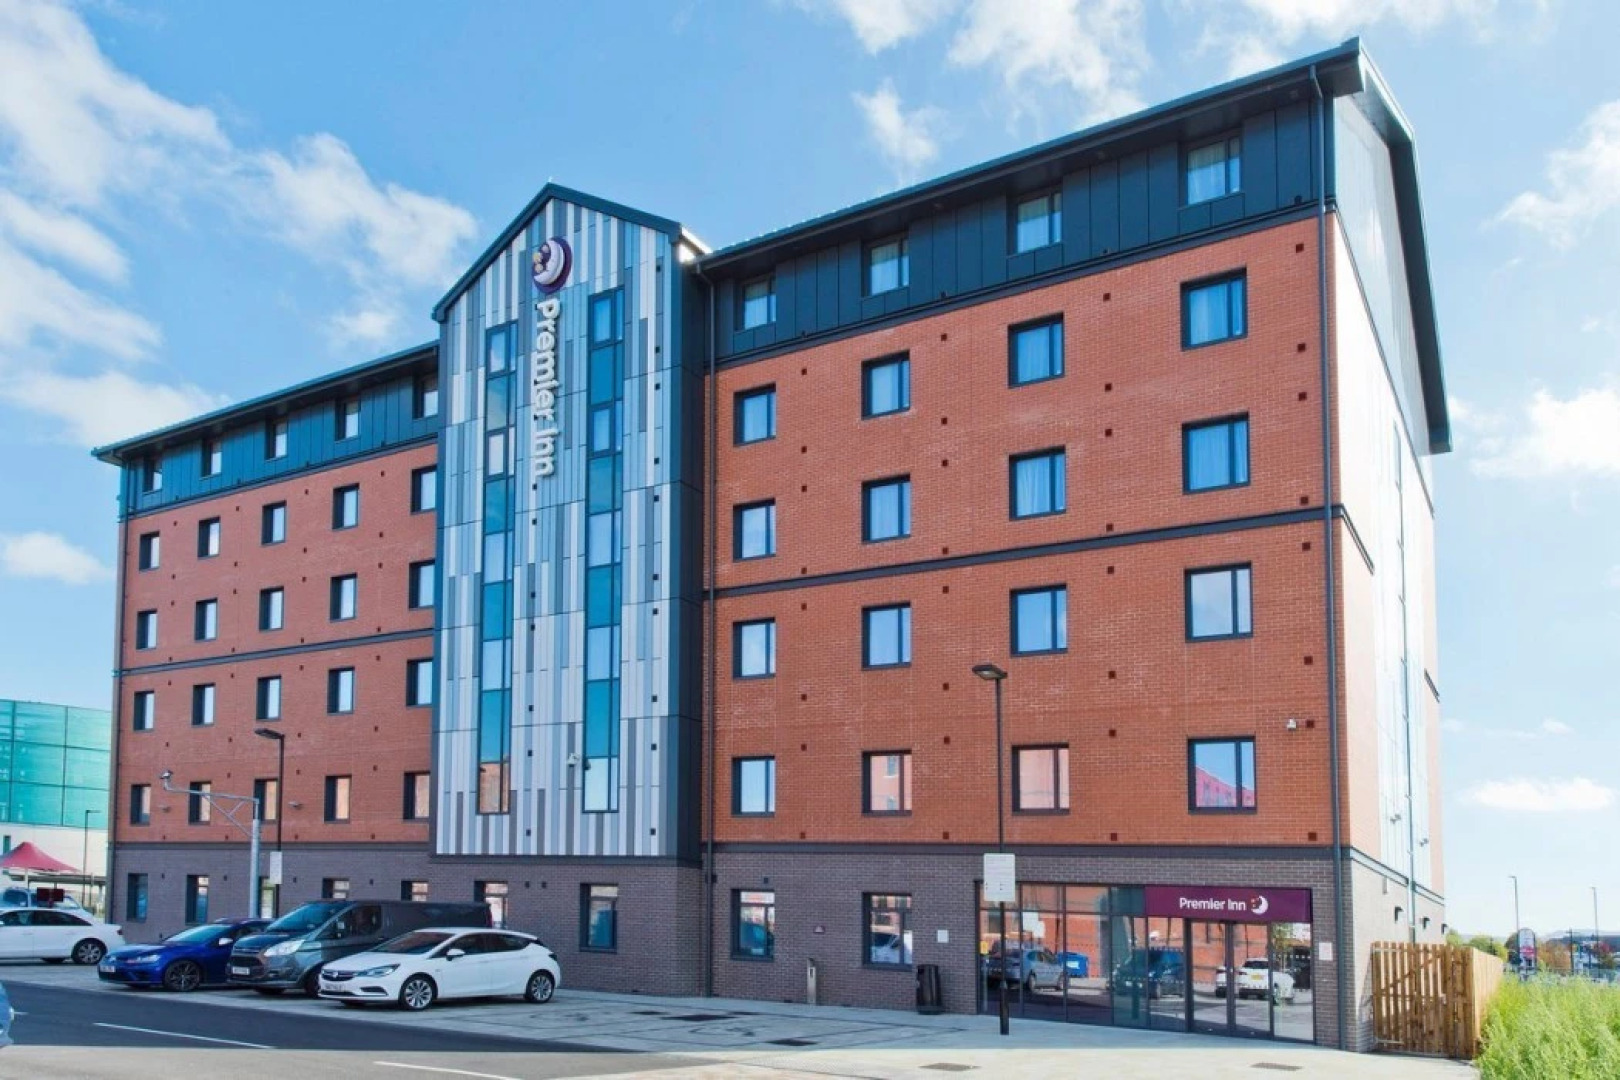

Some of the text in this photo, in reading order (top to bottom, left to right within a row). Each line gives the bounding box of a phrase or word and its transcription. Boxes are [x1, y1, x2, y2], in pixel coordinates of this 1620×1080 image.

[534, 299, 560, 478] Premier Inn
[1179, 897, 1247, 911] Premier Inn
